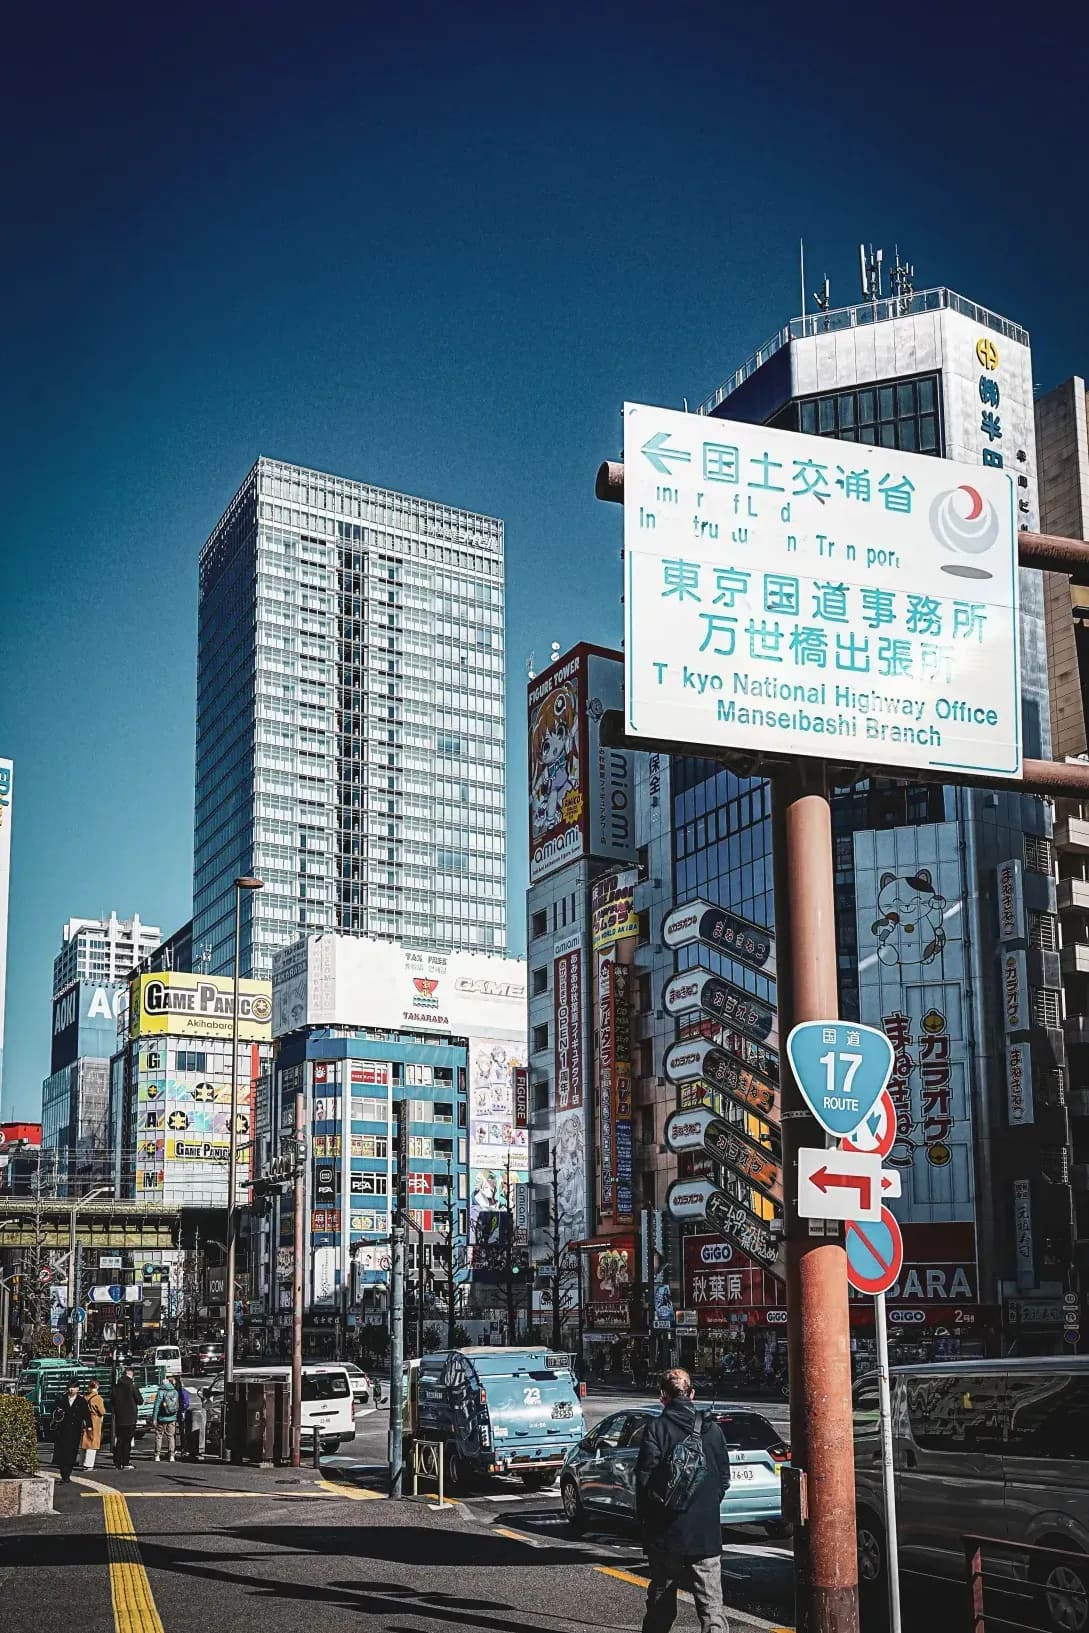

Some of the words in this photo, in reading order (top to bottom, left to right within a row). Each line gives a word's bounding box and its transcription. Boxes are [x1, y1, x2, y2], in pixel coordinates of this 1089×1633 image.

[702, 441, 916, 514] 国土交通省
[660, 558, 988, 644] 東京国道事務所
[698, 612, 955, 684] 万世橋出張所
[528, 681, 553, 706] FIGURE
[554, 657, 580, 686] TOWER
[733, 672, 826, 706] National
[835, 684, 925, 721] Highway
[935, 698, 998, 727] Office
[717, 699, 857, 738] Manseibashi
[866, 717, 942, 747] Branch
[535, 827, 579, 864] amiami
[555, 934, 580, 954] amiami
[713, 920, 766, 959] まねきねこ
[147, 983, 195, 1011] GAME
[200, 986, 251, 1016] PANC
[455, 977, 525, 999] GAME
[54, 990, 76, 1036] AOKI
[187, 1018, 233, 1030] Akihabara
[402, 1011, 449, 1025] TAKARADA
[713, 990, 759, 1025] カラオケ
[822, 1028, 861, 1047] 国道
[819, 1051, 863, 1093] 17
[919, 1035, 951, 1141] カラオケ
[516, 1076, 526, 1121] FIGURE
[823, 1096, 859, 1112] ROUTE
[352, 1180, 373, 1191] PSA
[710, 1197, 747, 1223] ゲームの
[702, 1246, 731, 1261] GiGO
[692, 1274, 743, 1303] 秋葉原
